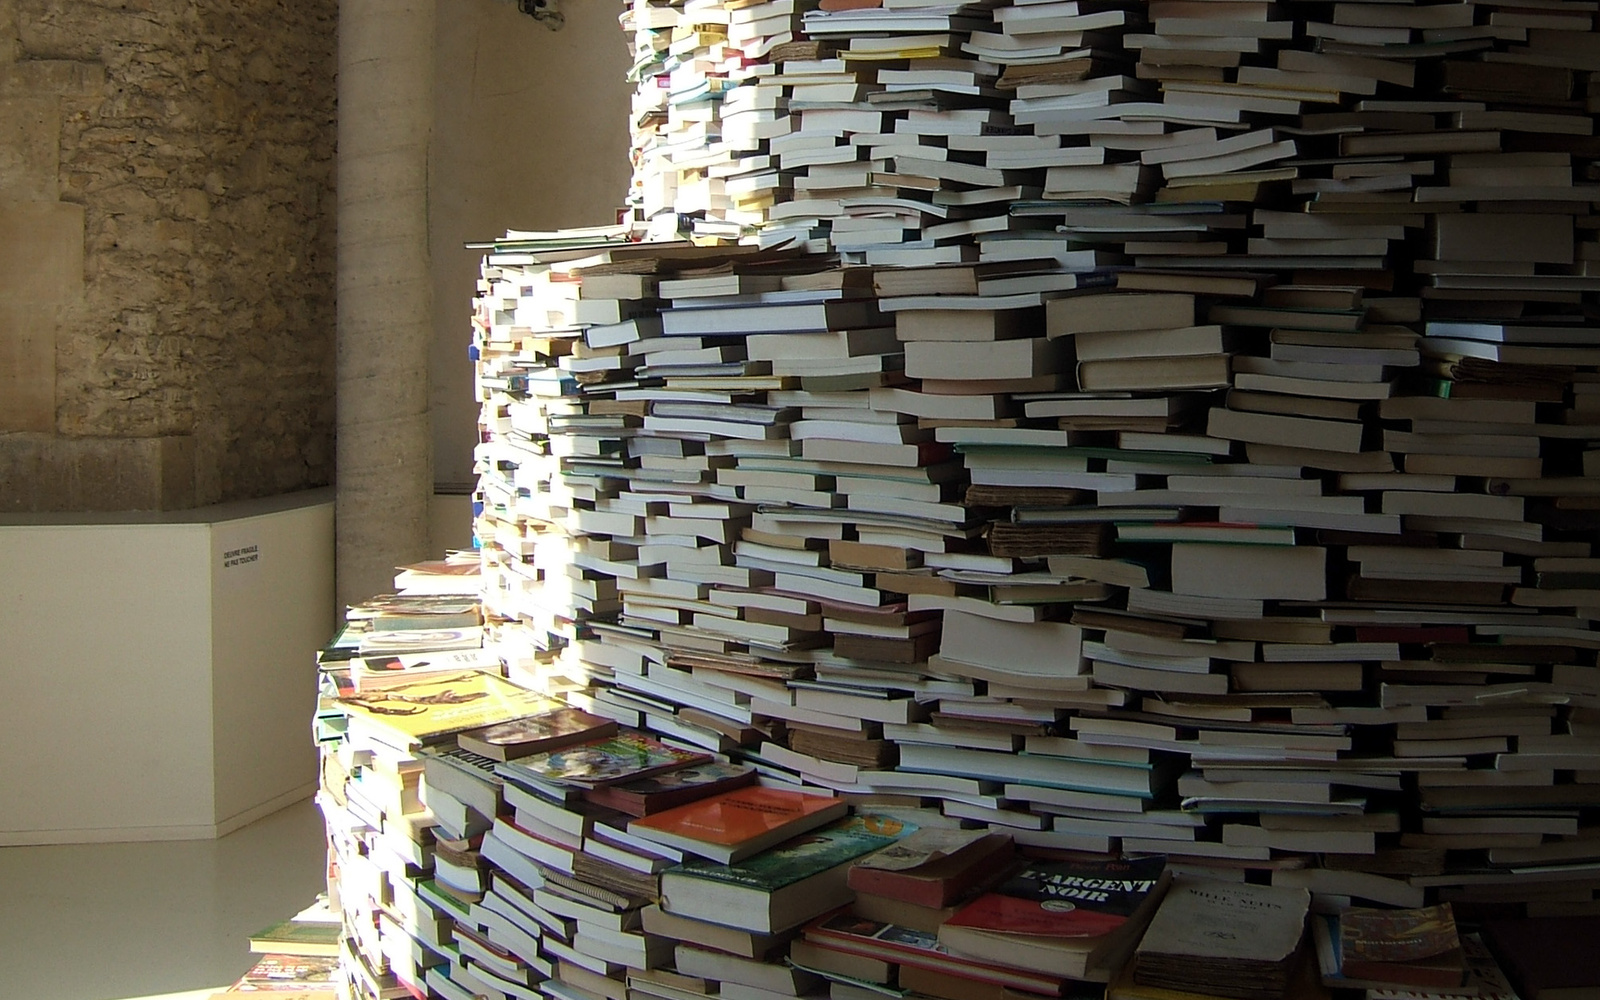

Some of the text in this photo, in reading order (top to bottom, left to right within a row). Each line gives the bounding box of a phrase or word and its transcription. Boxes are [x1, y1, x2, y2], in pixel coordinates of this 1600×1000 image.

[241, 545, 258, 553] FRAGILE
[240, 554, 258, 564] TOUCHER
[1020, 870, 1157, 892] L'ARGENT
[1039, 884, 1109, 902] NOIR
[1188, 888, 1232, 903] MILLE
